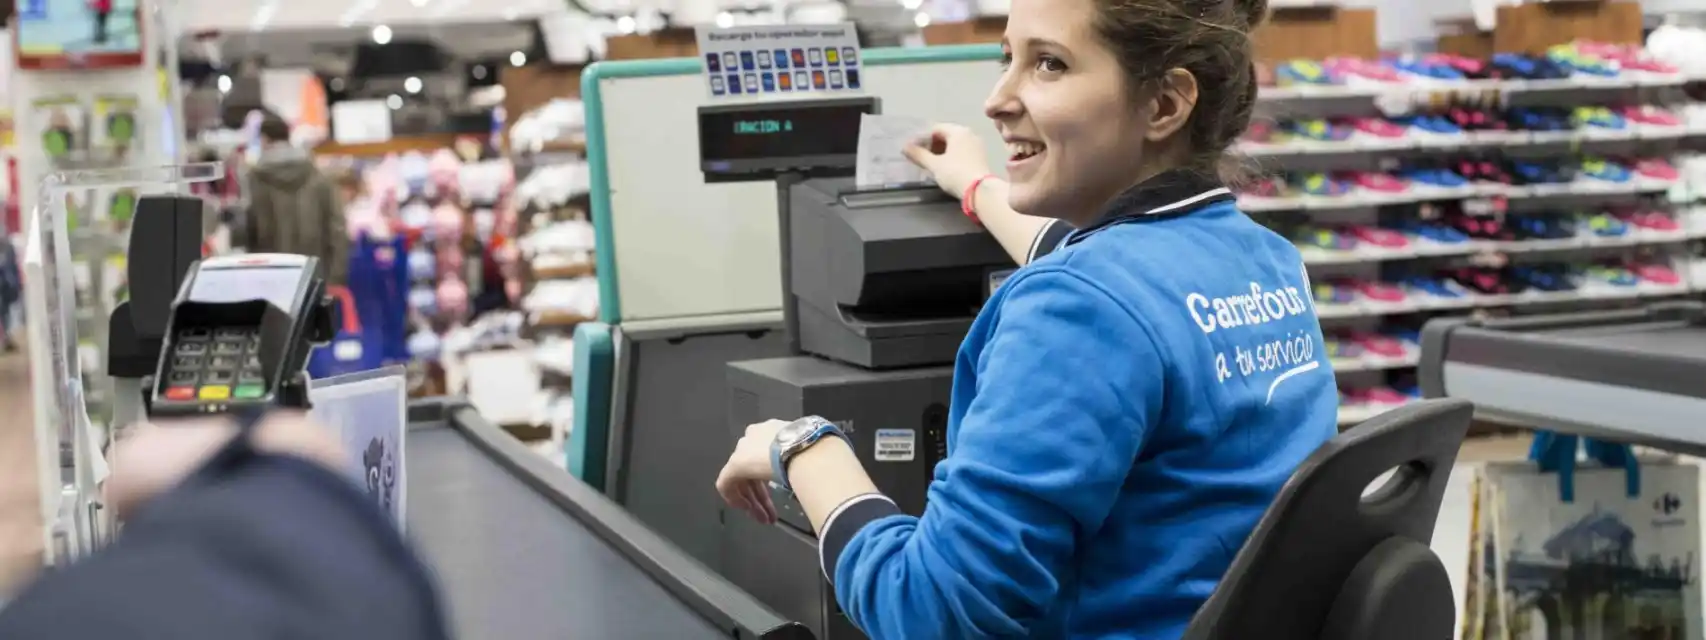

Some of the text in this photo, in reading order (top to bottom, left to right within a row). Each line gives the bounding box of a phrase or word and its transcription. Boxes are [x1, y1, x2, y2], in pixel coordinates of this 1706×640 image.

[1186, 281, 1307, 334] Carrefour
[1216, 329, 1314, 383] a tu servicio
